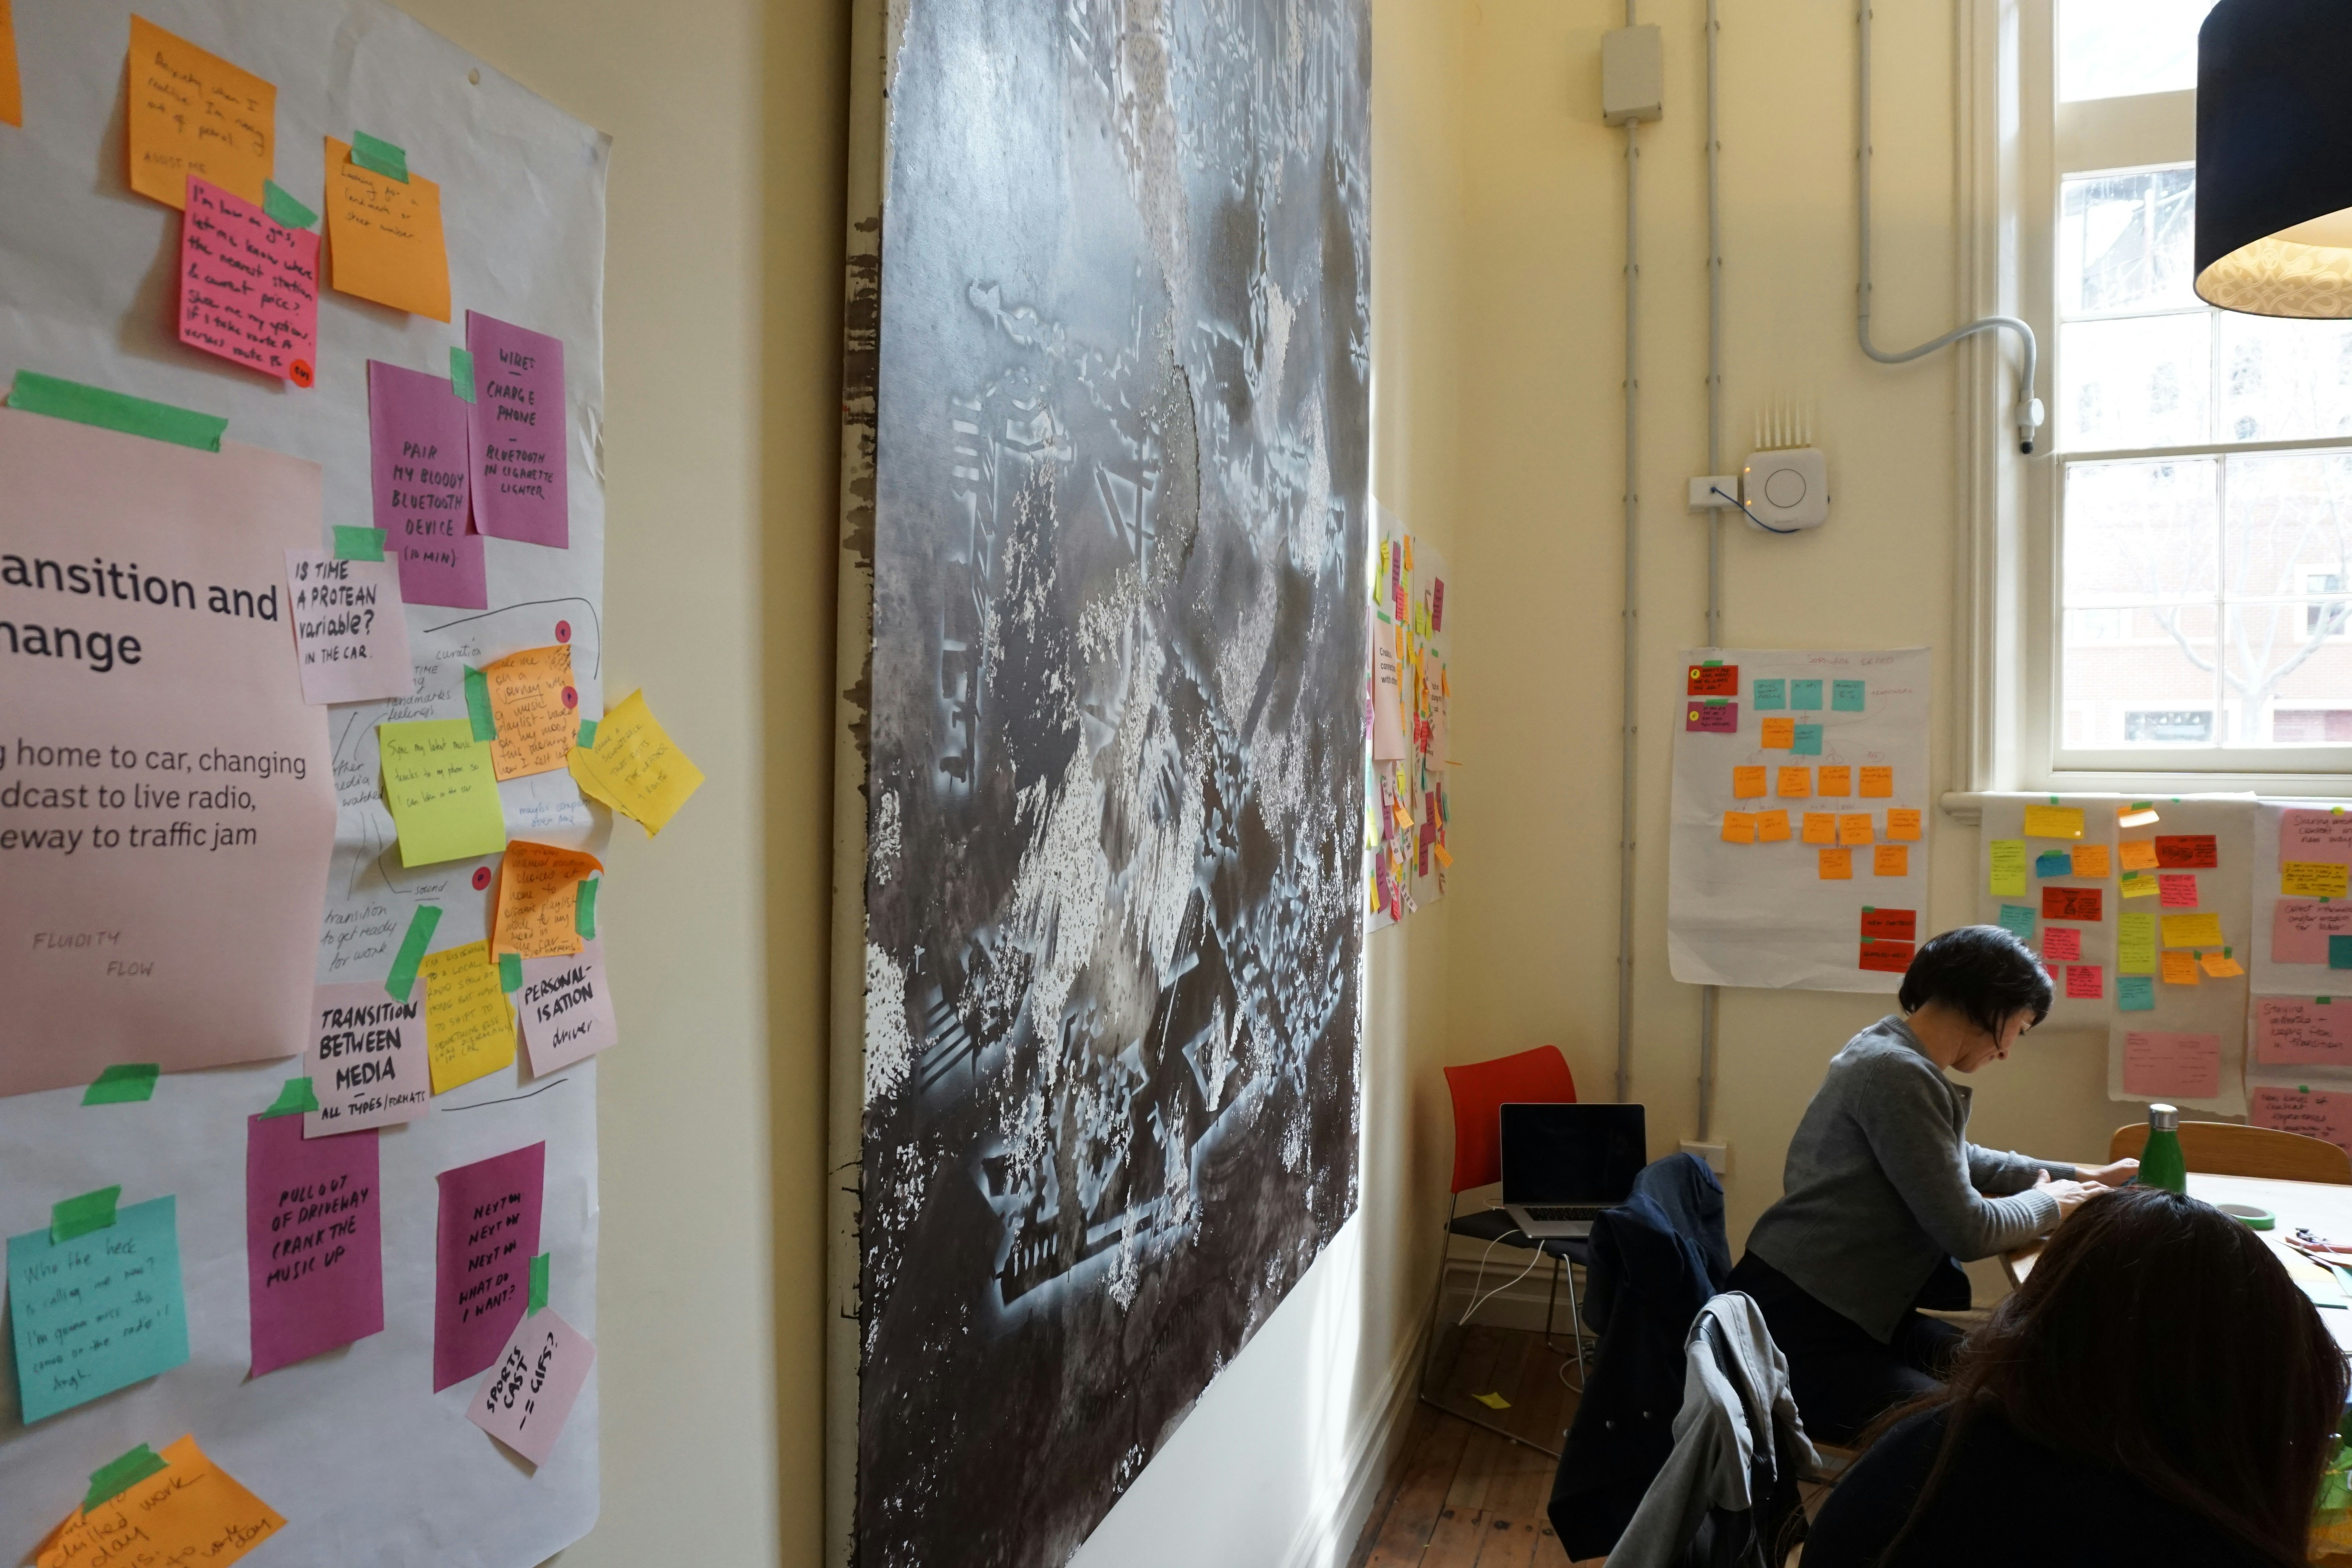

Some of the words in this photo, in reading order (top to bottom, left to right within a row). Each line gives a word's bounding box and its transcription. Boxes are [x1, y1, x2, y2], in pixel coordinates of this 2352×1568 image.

[220, 199, 242, 217] low
[249, 216, 261, 227] on
[187, 236, 212, 254] the
[220, 254, 263, 276] nearest
[216, 230, 237, 247] me
[246, 239, 278, 264] know
[284, 261, 312, 279] where
[204, 276, 254, 294] current
[214, 317, 241, 334] take
[247, 333, 276, 347] route
[282, 339, 292, 348] A
[248, 314, 264, 330] my
[233, 347, 263, 361] route
[487, 380, 535, 405] CHARGE
[497, 405, 537, 426] PHONE
[403, 441, 438, 459] PAIR
[486, 445, 545, 464] BLUETOOTH
[393, 464, 414, 482] MY
[420, 468, 464, 490] BLOODY
[485, 465, 497, 476] IN
[503, 466, 554, 483] CIGARETTE
[392, 490, 462, 510] BLUETOOTH
[501, 483, 545, 500] LIGHTER
[406, 519, 454, 537] DEVICE
[296, 561, 309, 581] IS
[315, 560, 349, 580] TIME
[1, 554, 196, 610] ansition
[208, 584, 278, 622] and
[297, 589, 306, 610] A
[311, 584, 377, 607] PROTEAN
[299, 609, 375, 639] variable?
[305, 652, 315, 665] IN
[321, 646, 339, 663] THE
[1380, 647, 1390, 657] Create
[1381, 675, 1391, 683] with
[387, 691, 451, 708] landmarks
[17, 737, 101, 768] home
[111, 744, 137, 769] to
[145, 749, 192, 774] car,
[199, 747, 306, 779] changing
[395, 768, 418, 782] tracks
[1, 780, 90, 808] dcast
[99, 784, 125, 809] to
[134, 784, 180, 809] live
[188, 785, 257, 812] radio,
[342, 786, 383, 806] watched
[0, 827, 83, 856] eway
[93, 824, 120, 848] to
[129, 820, 207, 848] traffic
[210, 823, 257, 851] jam
[414, 880, 448, 895] sound
[325, 902, 387, 924] transition
[33, 931, 121, 949] FLUIDITY
[321, 929, 334, 946] to
[337, 926, 358, 950] get
[359, 920, 397, 937] ready
[107, 961, 154, 976] FLOW
[329, 952, 350, 972] for
[354, 940, 387, 960] work
[452, 962, 483, 975] LOCAL
[322, 1000, 418, 1029] TRANSITION
[537, 982, 593, 1024] ISATION
[319, 1026, 401, 1059] BETWEEN
[553, 1020, 592, 1048] driver
[336, 1055, 396, 1091] MEDIA
[321, 1107, 341, 1120] ALL
[279, 1185, 313, 1207] PULL
[319, 1174, 348, 1195] OUT
[272, 1211, 292, 1231] OF
[298, 1188, 368, 1224] DRIVEWAY
[474, 1196, 506, 1220] NEXT
[272, 1228, 324, 1259] CRANK
[329, 1216, 356, 1239] THE
[469, 1221, 502, 1246] NEXT
[24, 1259, 57, 1284] Who
[67, 1250, 91, 1270] the
[105, 1237, 136, 1256] heck
[267, 1257, 315, 1287] MUSIC
[324, 1246, 345, 1267] UP
[468, 1247, 500, 1272] NEXT
[43, 1287, 82, 1307] calling
[94, 1276, 111, 1289] me
[459, 1277, 493, 1305] WHAT
[496, 1272, 509, 1286] DO
[463, 1308, 469, 1323] I
[475, 1284, 515, 1316] WANT?
[54, 1320, 87, 1345] gonna
[90, 1337, 110, 1350] the
[531, 1332, 558, 1394] GIFS?
[487, 1345, 521, 1414] SPORTS
[504, 1355, 527, 1408] CAST
[92, 1526, 149, 1567] day
